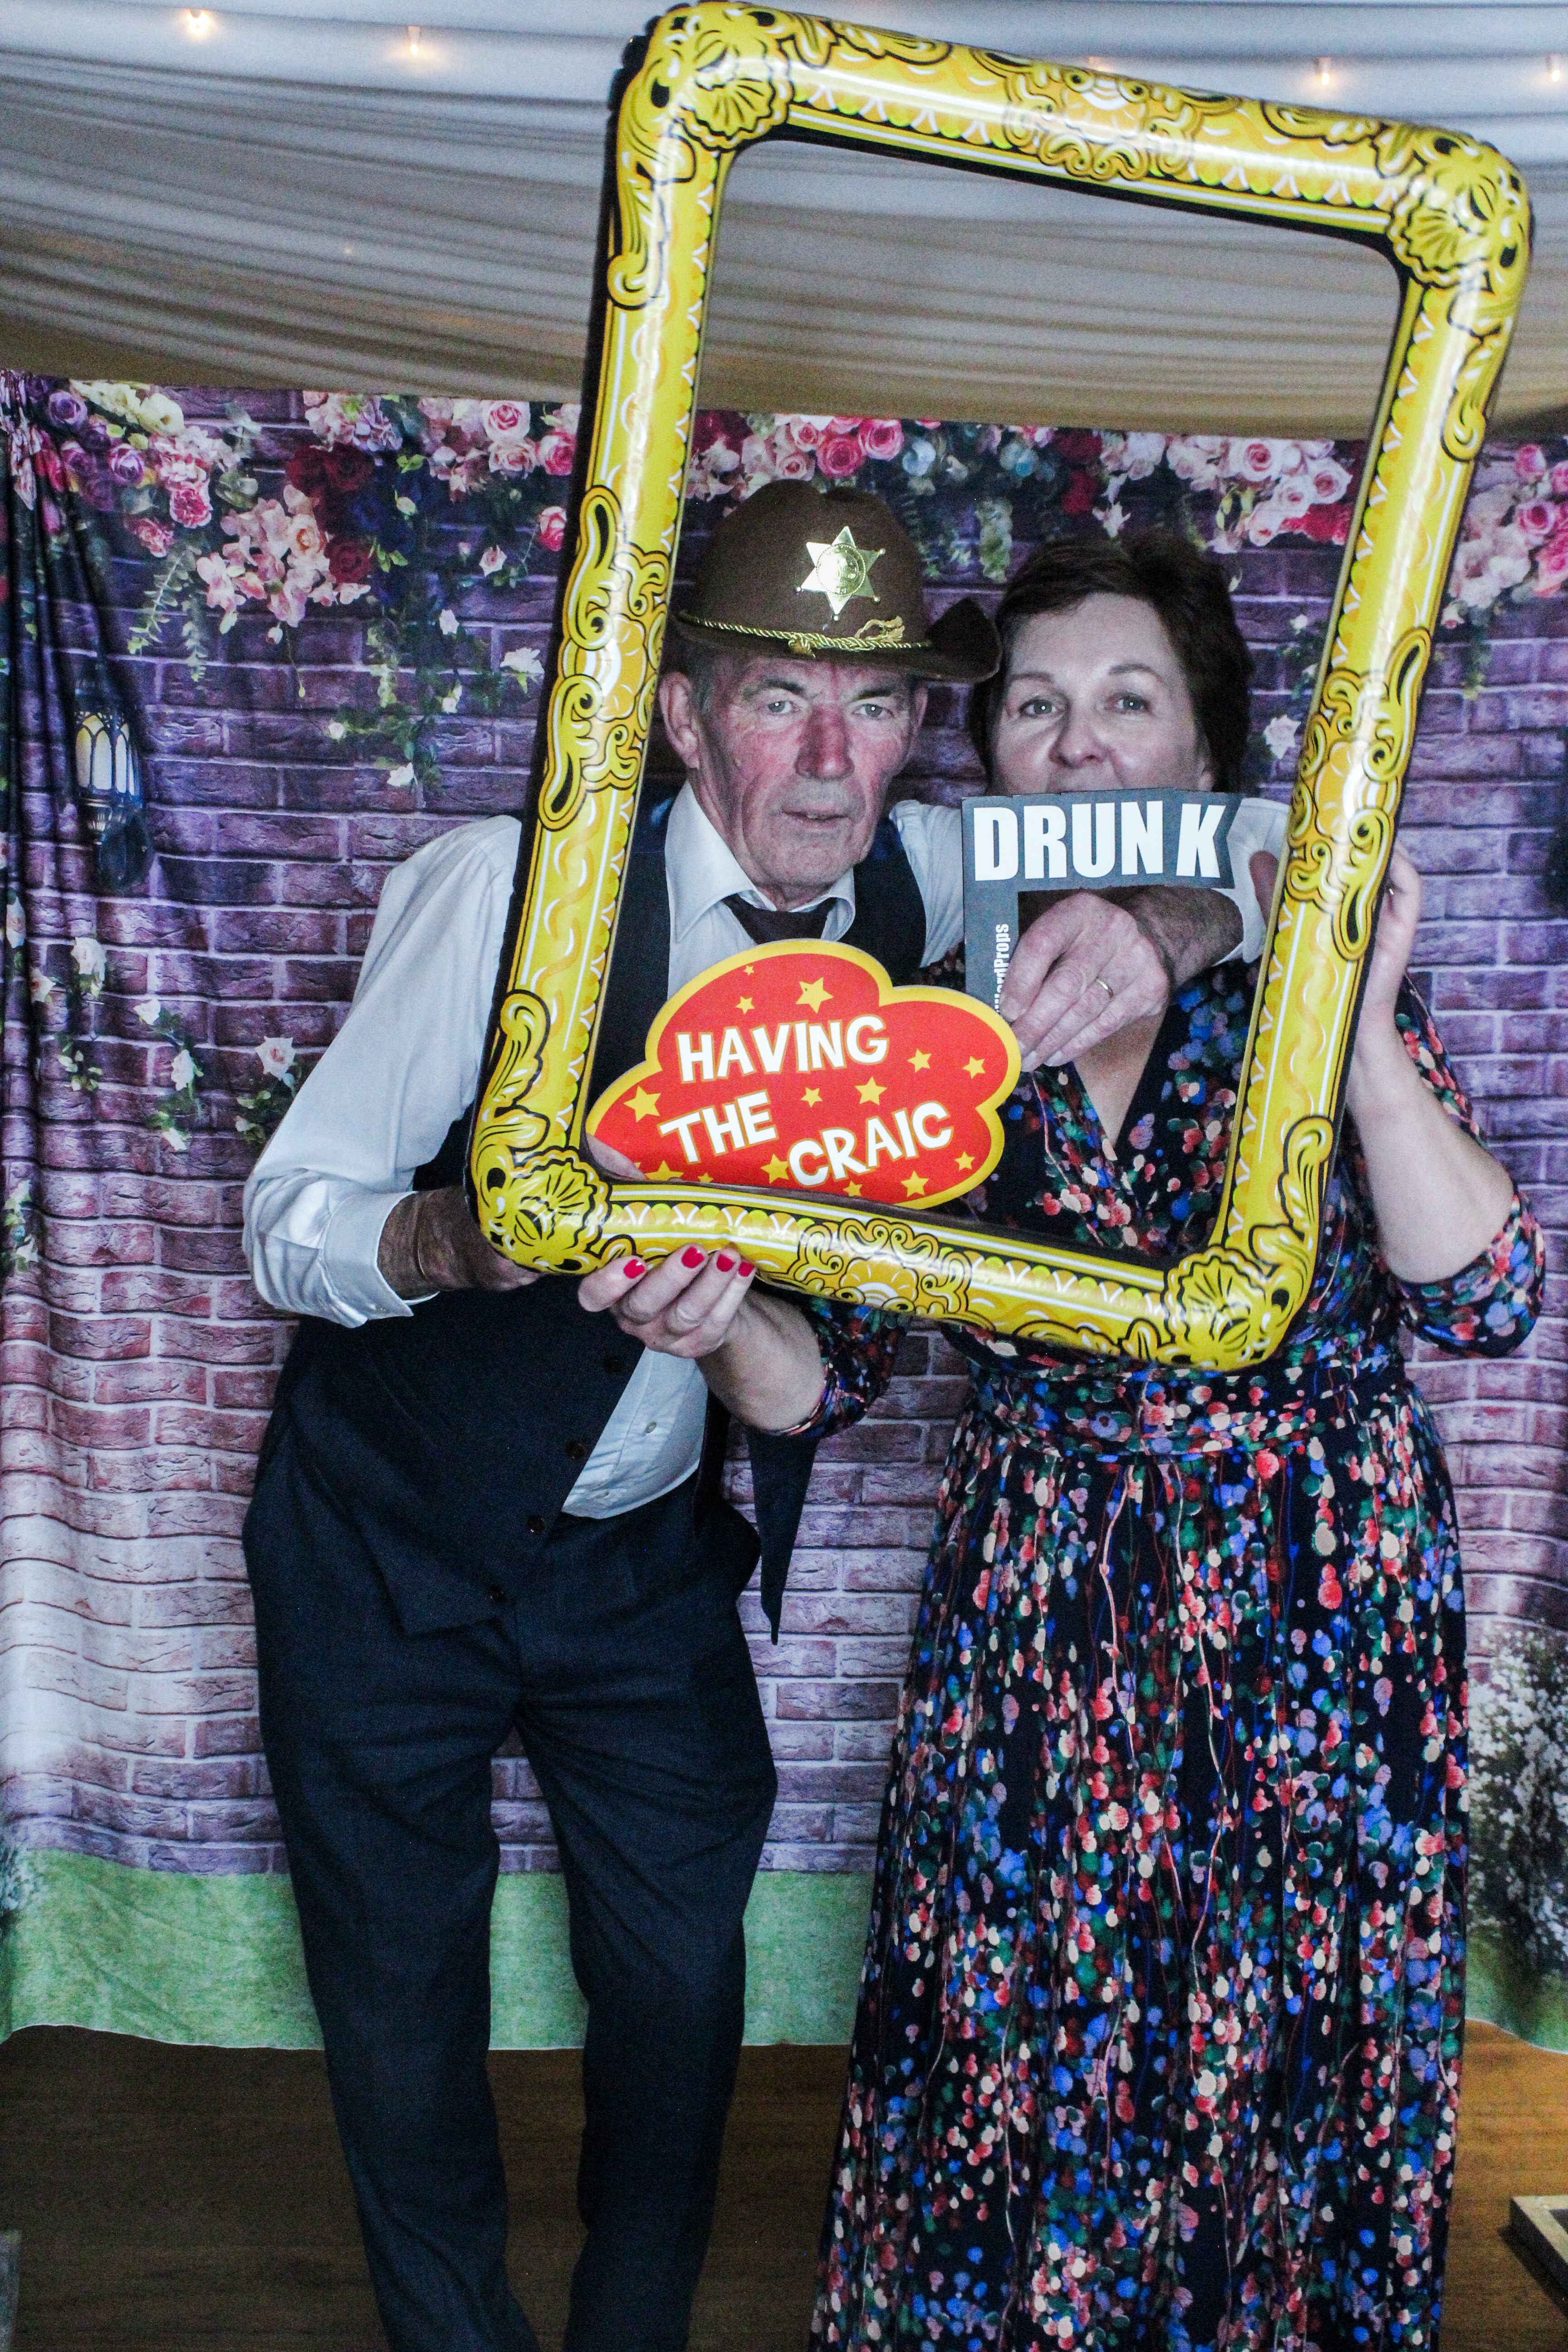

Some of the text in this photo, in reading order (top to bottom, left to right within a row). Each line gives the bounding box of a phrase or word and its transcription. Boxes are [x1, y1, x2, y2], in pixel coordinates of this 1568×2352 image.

[676, 1014, 889, 1083] HAVING
[659, 1091, 954, 1186] THE CRAIC
